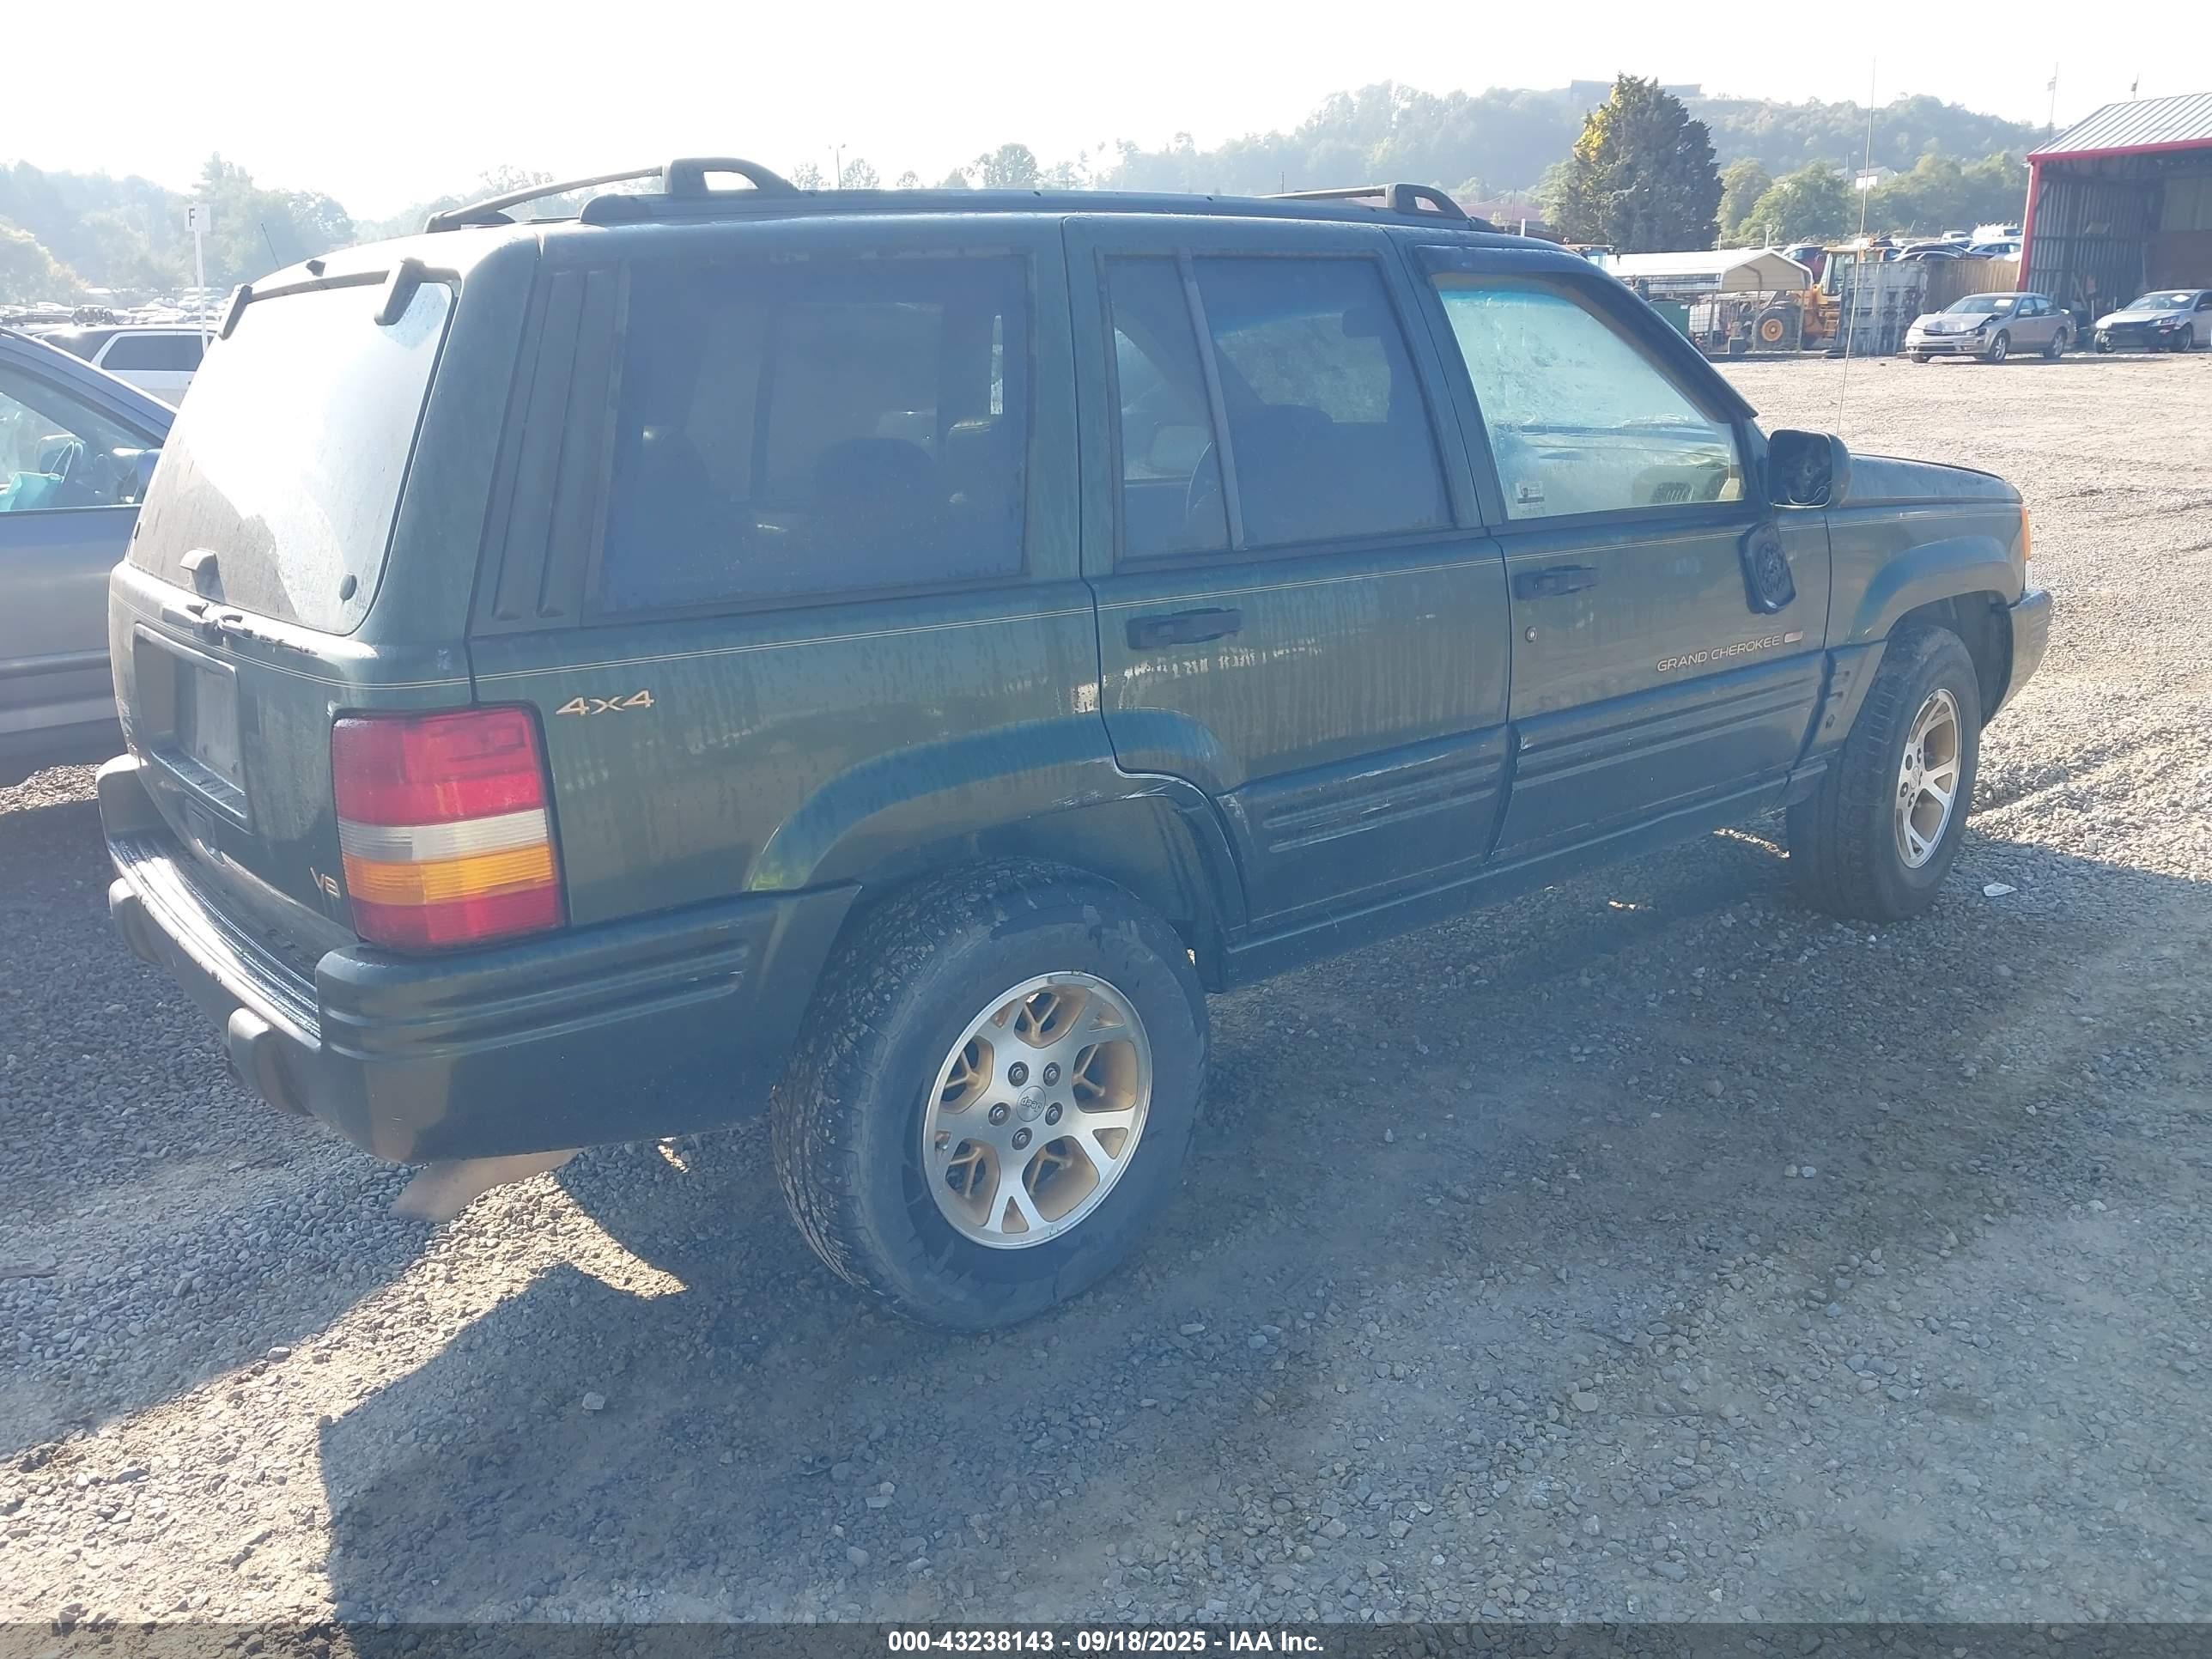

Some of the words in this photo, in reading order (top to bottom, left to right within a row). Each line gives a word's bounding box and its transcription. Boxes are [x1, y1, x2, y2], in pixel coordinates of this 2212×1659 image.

[188, 208, 196, 228] F
[1656, 651, 1708, 672] GRAND
[1711, 635, 1781, 660] CHEROKEE
